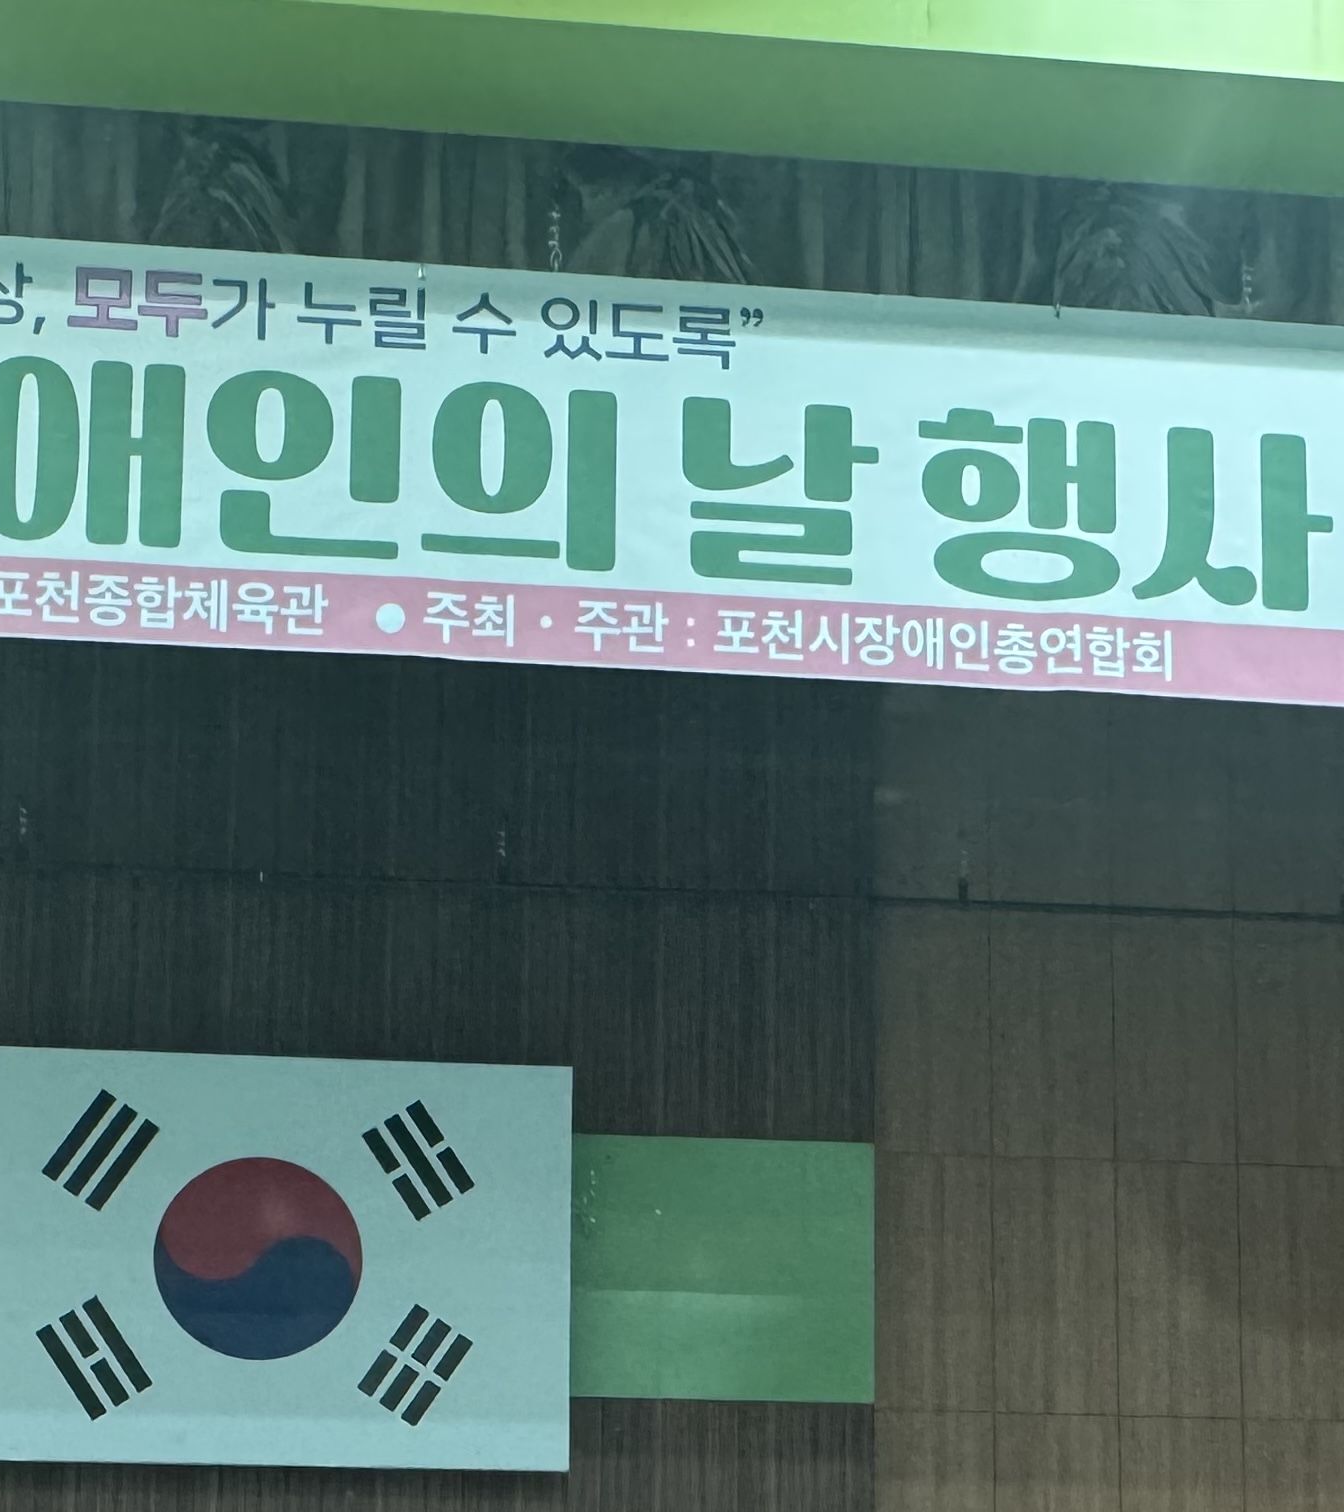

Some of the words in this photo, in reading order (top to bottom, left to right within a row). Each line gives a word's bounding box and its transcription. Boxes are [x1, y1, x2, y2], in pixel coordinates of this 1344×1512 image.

[67, 265, 276, 341] 모두가
[297, 281, 427, 351] 누릴
[452, 291, 517, 354] 수
[681, 396, 880, 587] 날
[918, 407, 1334, 612] 행사
[422, 589, 515, 647] 주최
[572, 600, 668, 654] 주관
[712, 610, 1174, 683] 포천시장애인총연합회
